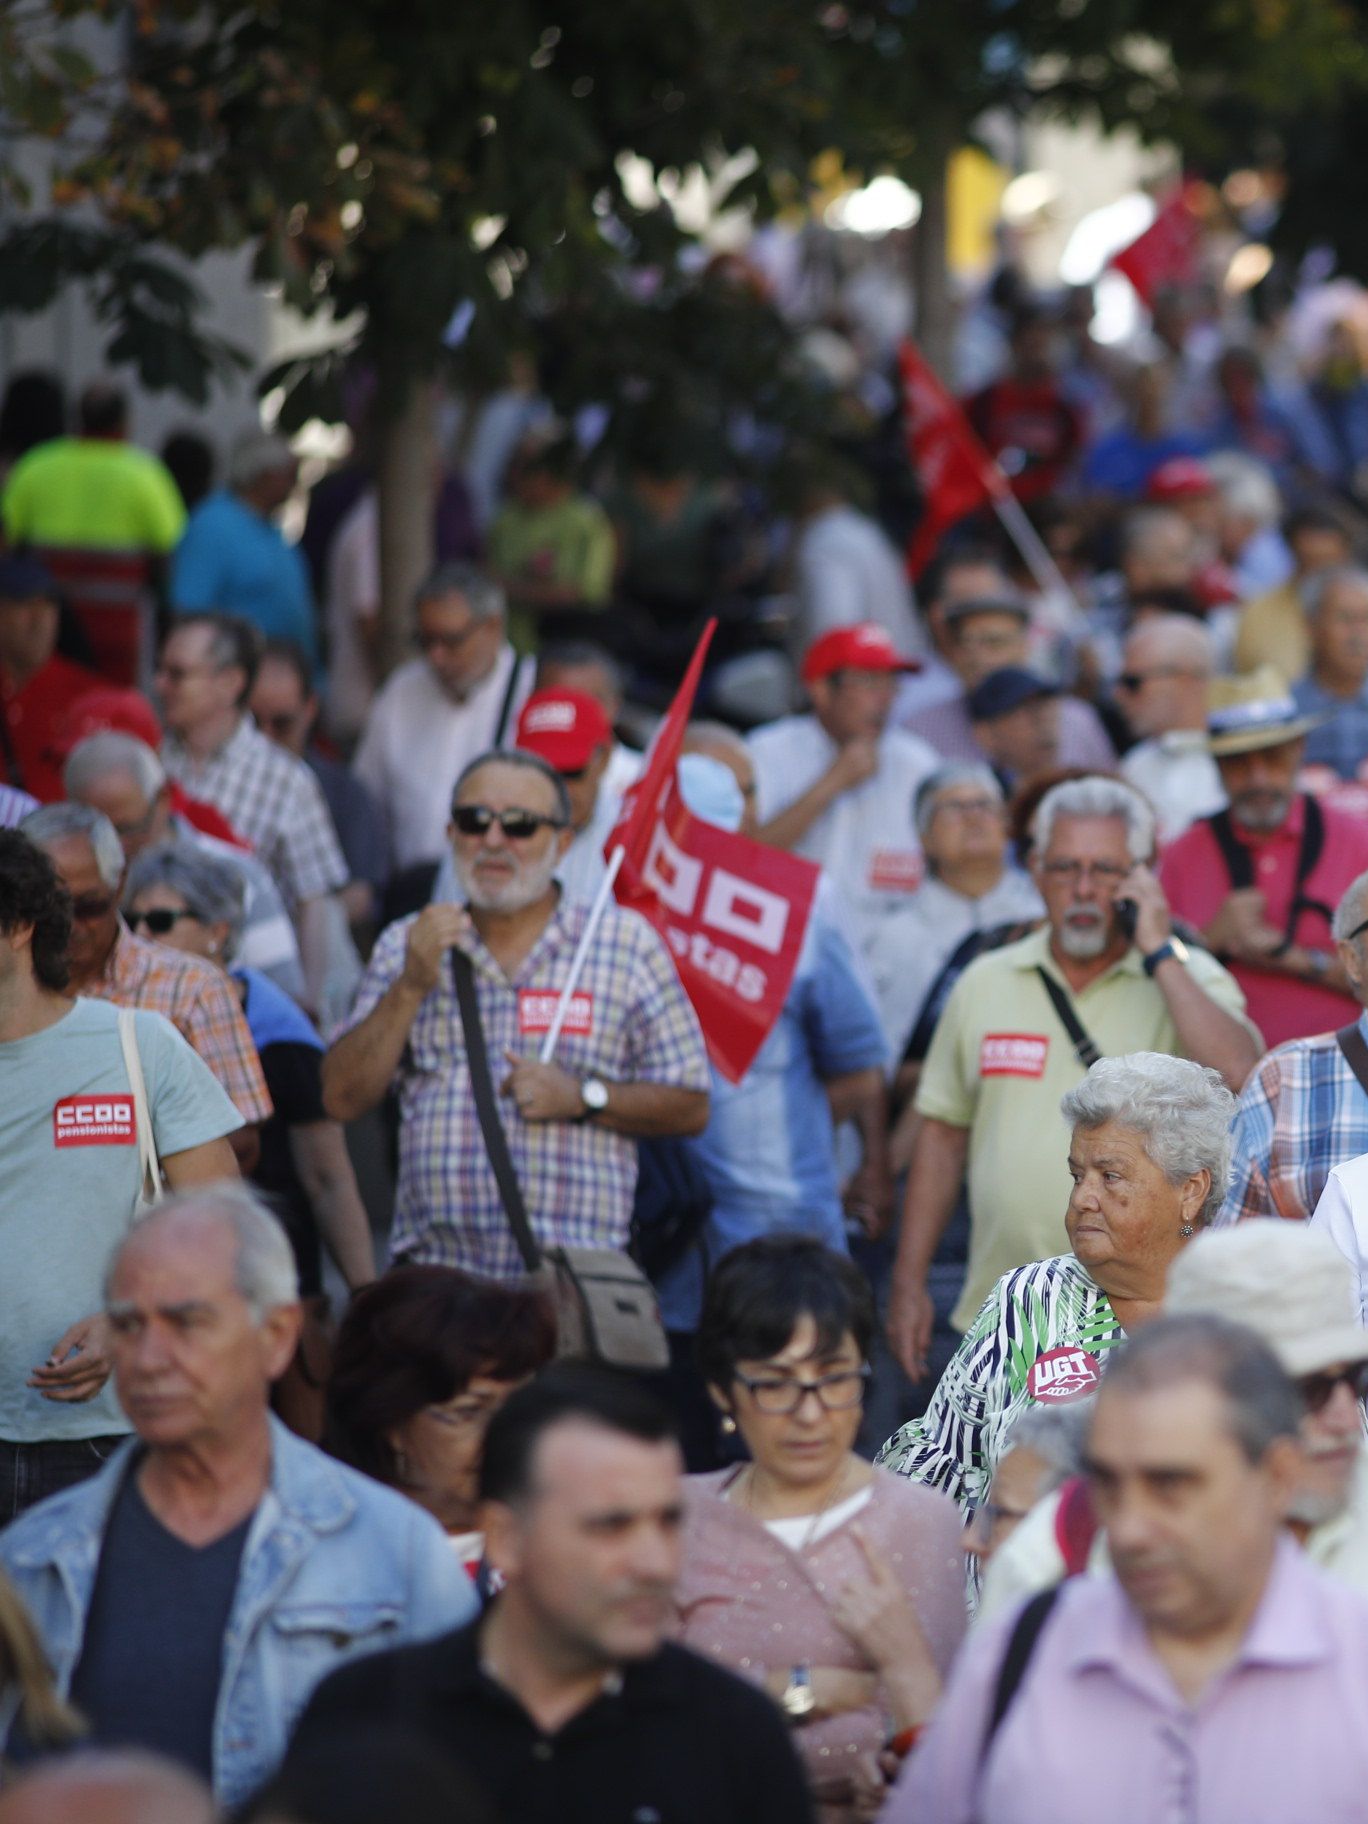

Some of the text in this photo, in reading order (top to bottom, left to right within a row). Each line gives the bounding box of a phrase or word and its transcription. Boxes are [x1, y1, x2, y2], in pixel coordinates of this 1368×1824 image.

[57, 1103, 132, 1125] CCOO
[57, 1122, 132, 1140] pensionistas
[1034, 1350, 1090, 1388] UGT
